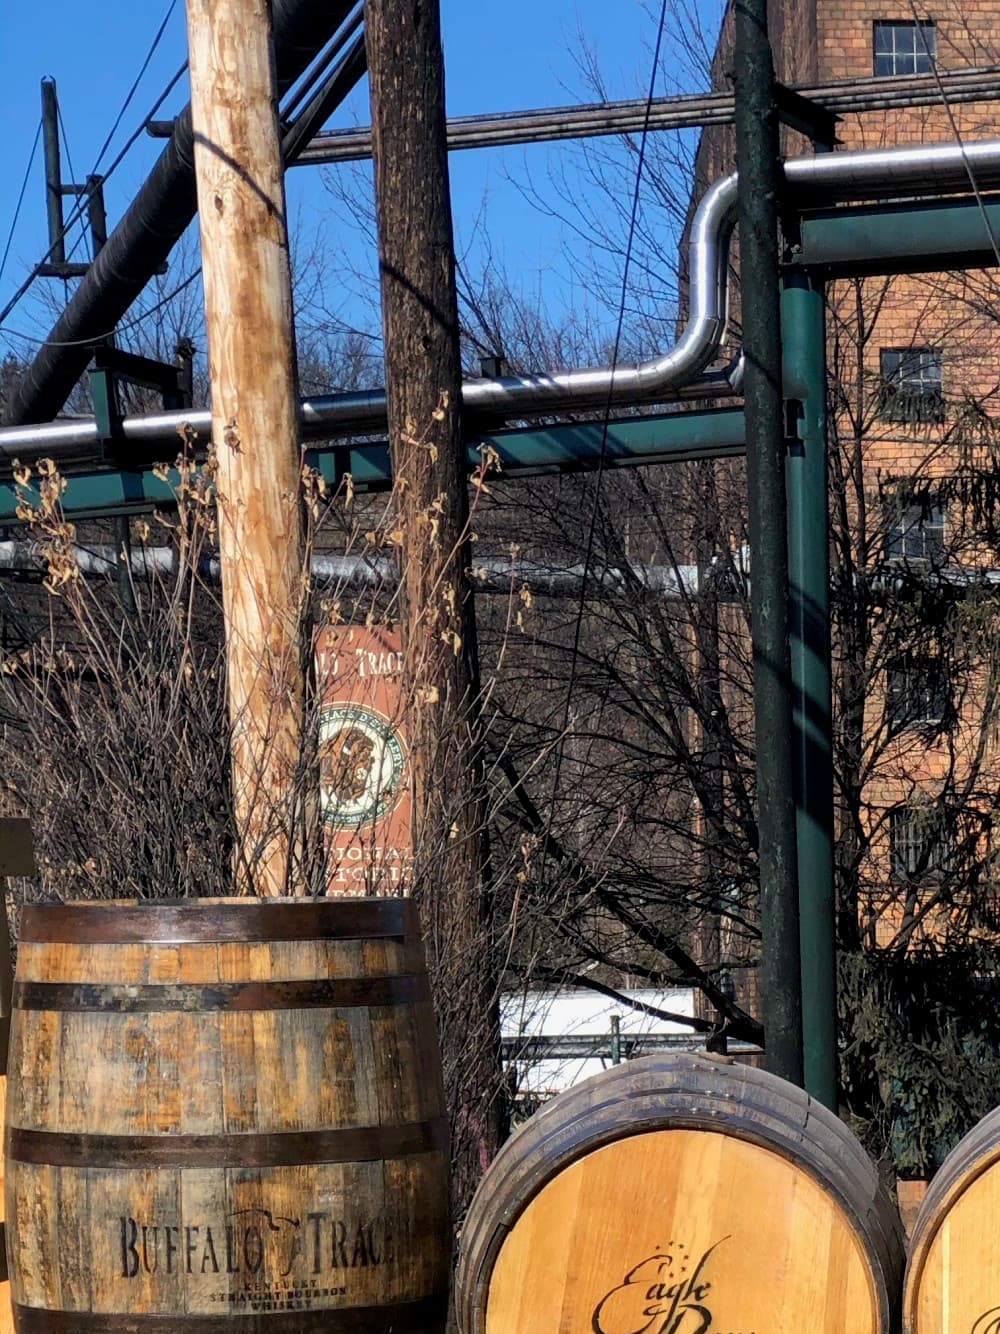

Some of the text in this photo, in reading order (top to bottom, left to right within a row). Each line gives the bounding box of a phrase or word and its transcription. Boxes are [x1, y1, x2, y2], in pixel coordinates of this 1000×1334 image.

[119, 1216, 264, 1278] BUFFALO
[210, 1287, 347, 1302] STRAIGHT BOURBON
